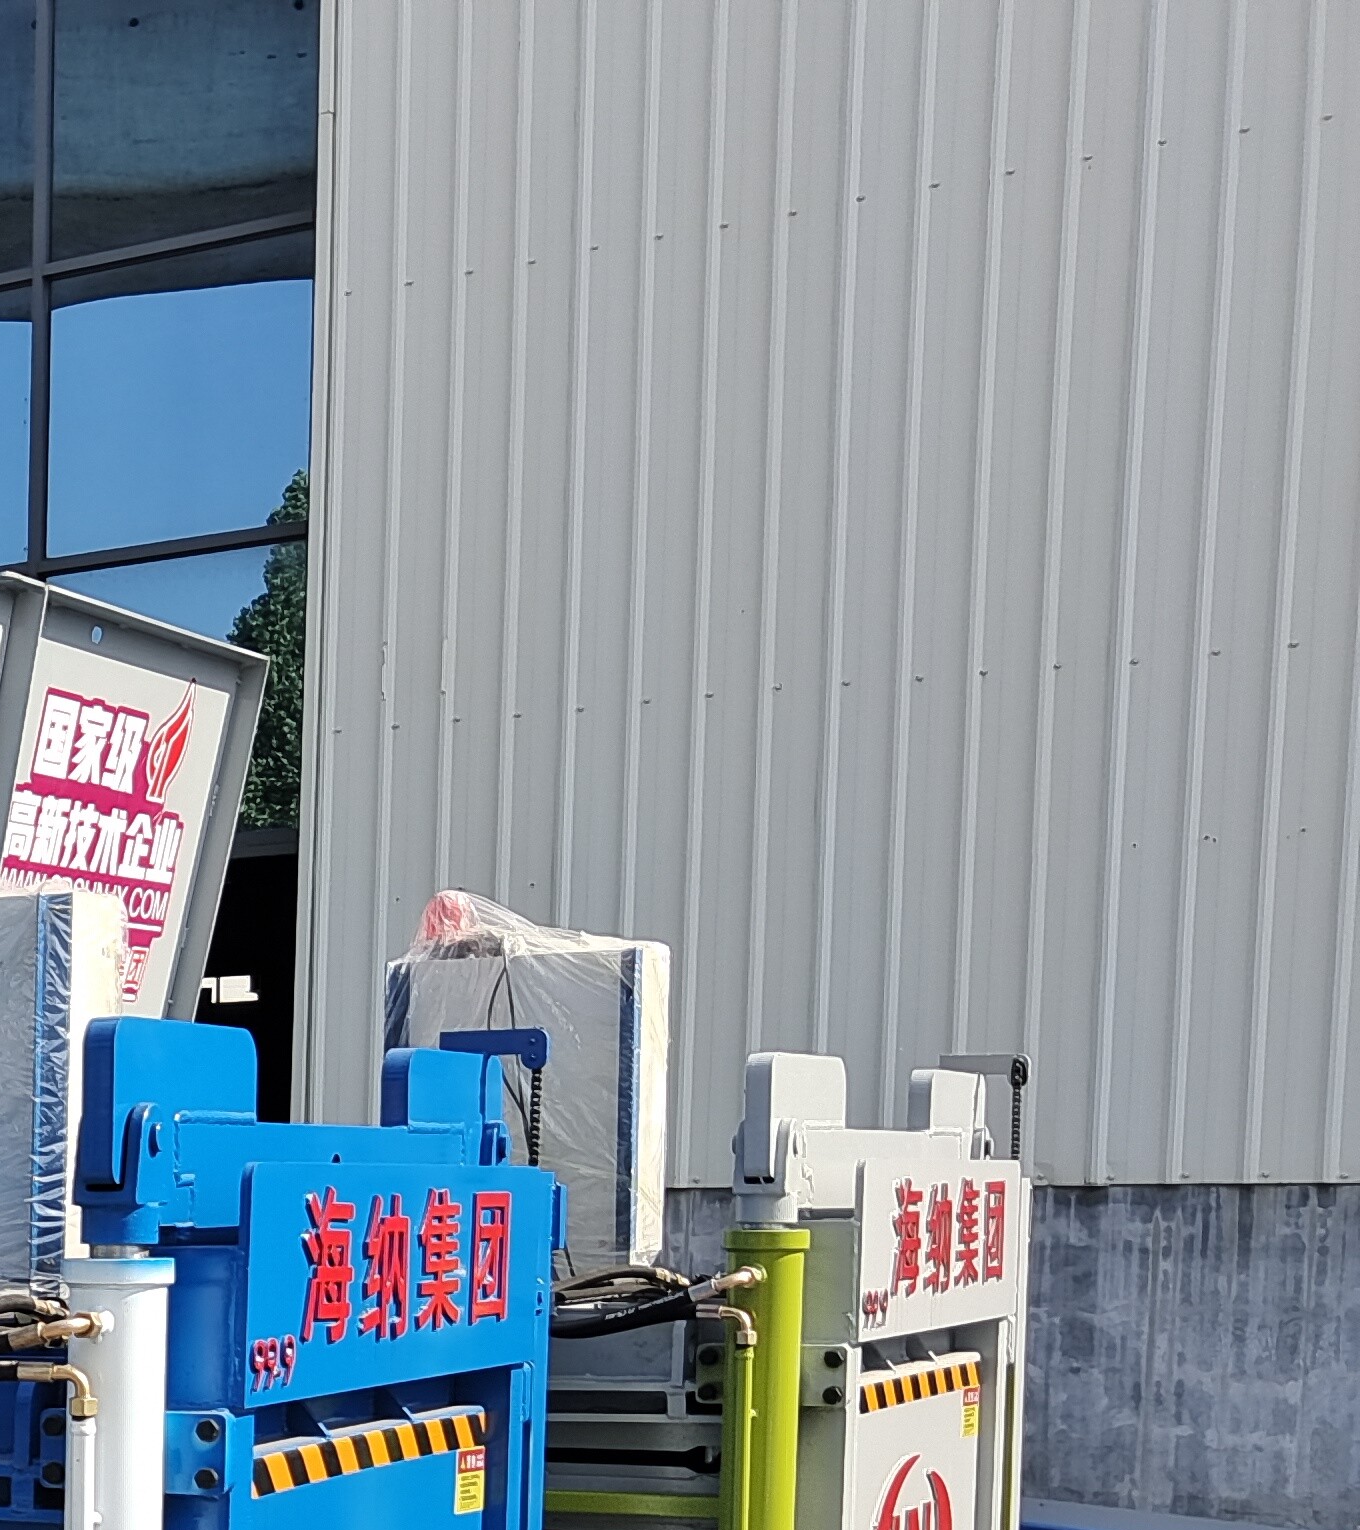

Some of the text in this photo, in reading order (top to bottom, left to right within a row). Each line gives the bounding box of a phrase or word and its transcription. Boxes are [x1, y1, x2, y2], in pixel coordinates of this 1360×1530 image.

[33, 697, 149, 795] 国家级
[5, 789, 182, 885] 高新技术企业
[300, 1185, 512, 1343] 海纳集团
[890, 1177, 1006, 1299] 海纳集团
